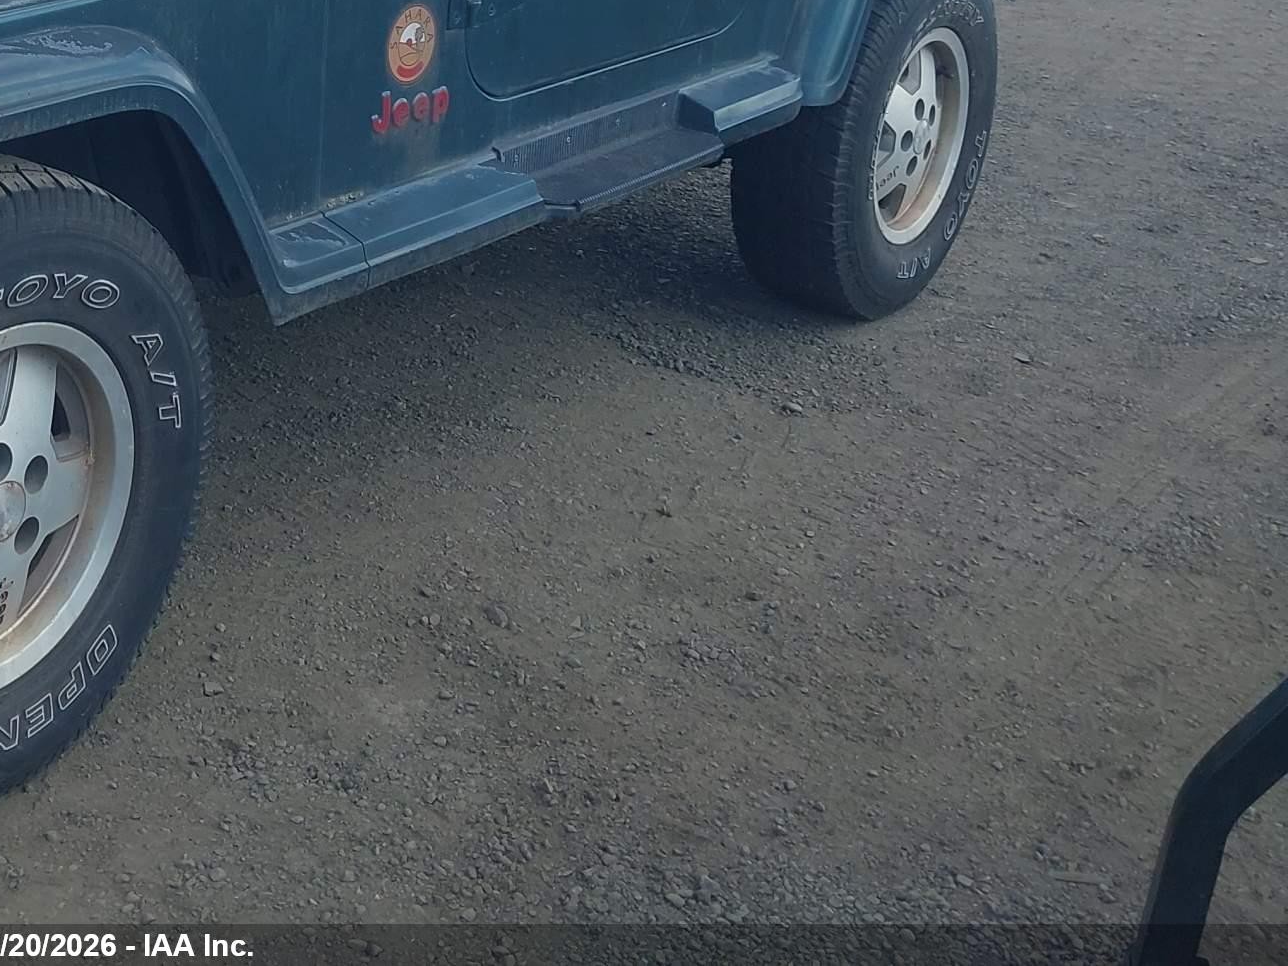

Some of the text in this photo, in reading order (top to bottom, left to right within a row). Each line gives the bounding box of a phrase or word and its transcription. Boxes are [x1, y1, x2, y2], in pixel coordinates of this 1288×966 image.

[389, 9, 434, 50] SAHARA
[371, 86, 450, 133] Jeep
[943, 130, 987, 241] TOYO
[131, 331, 183, 428] A/T
